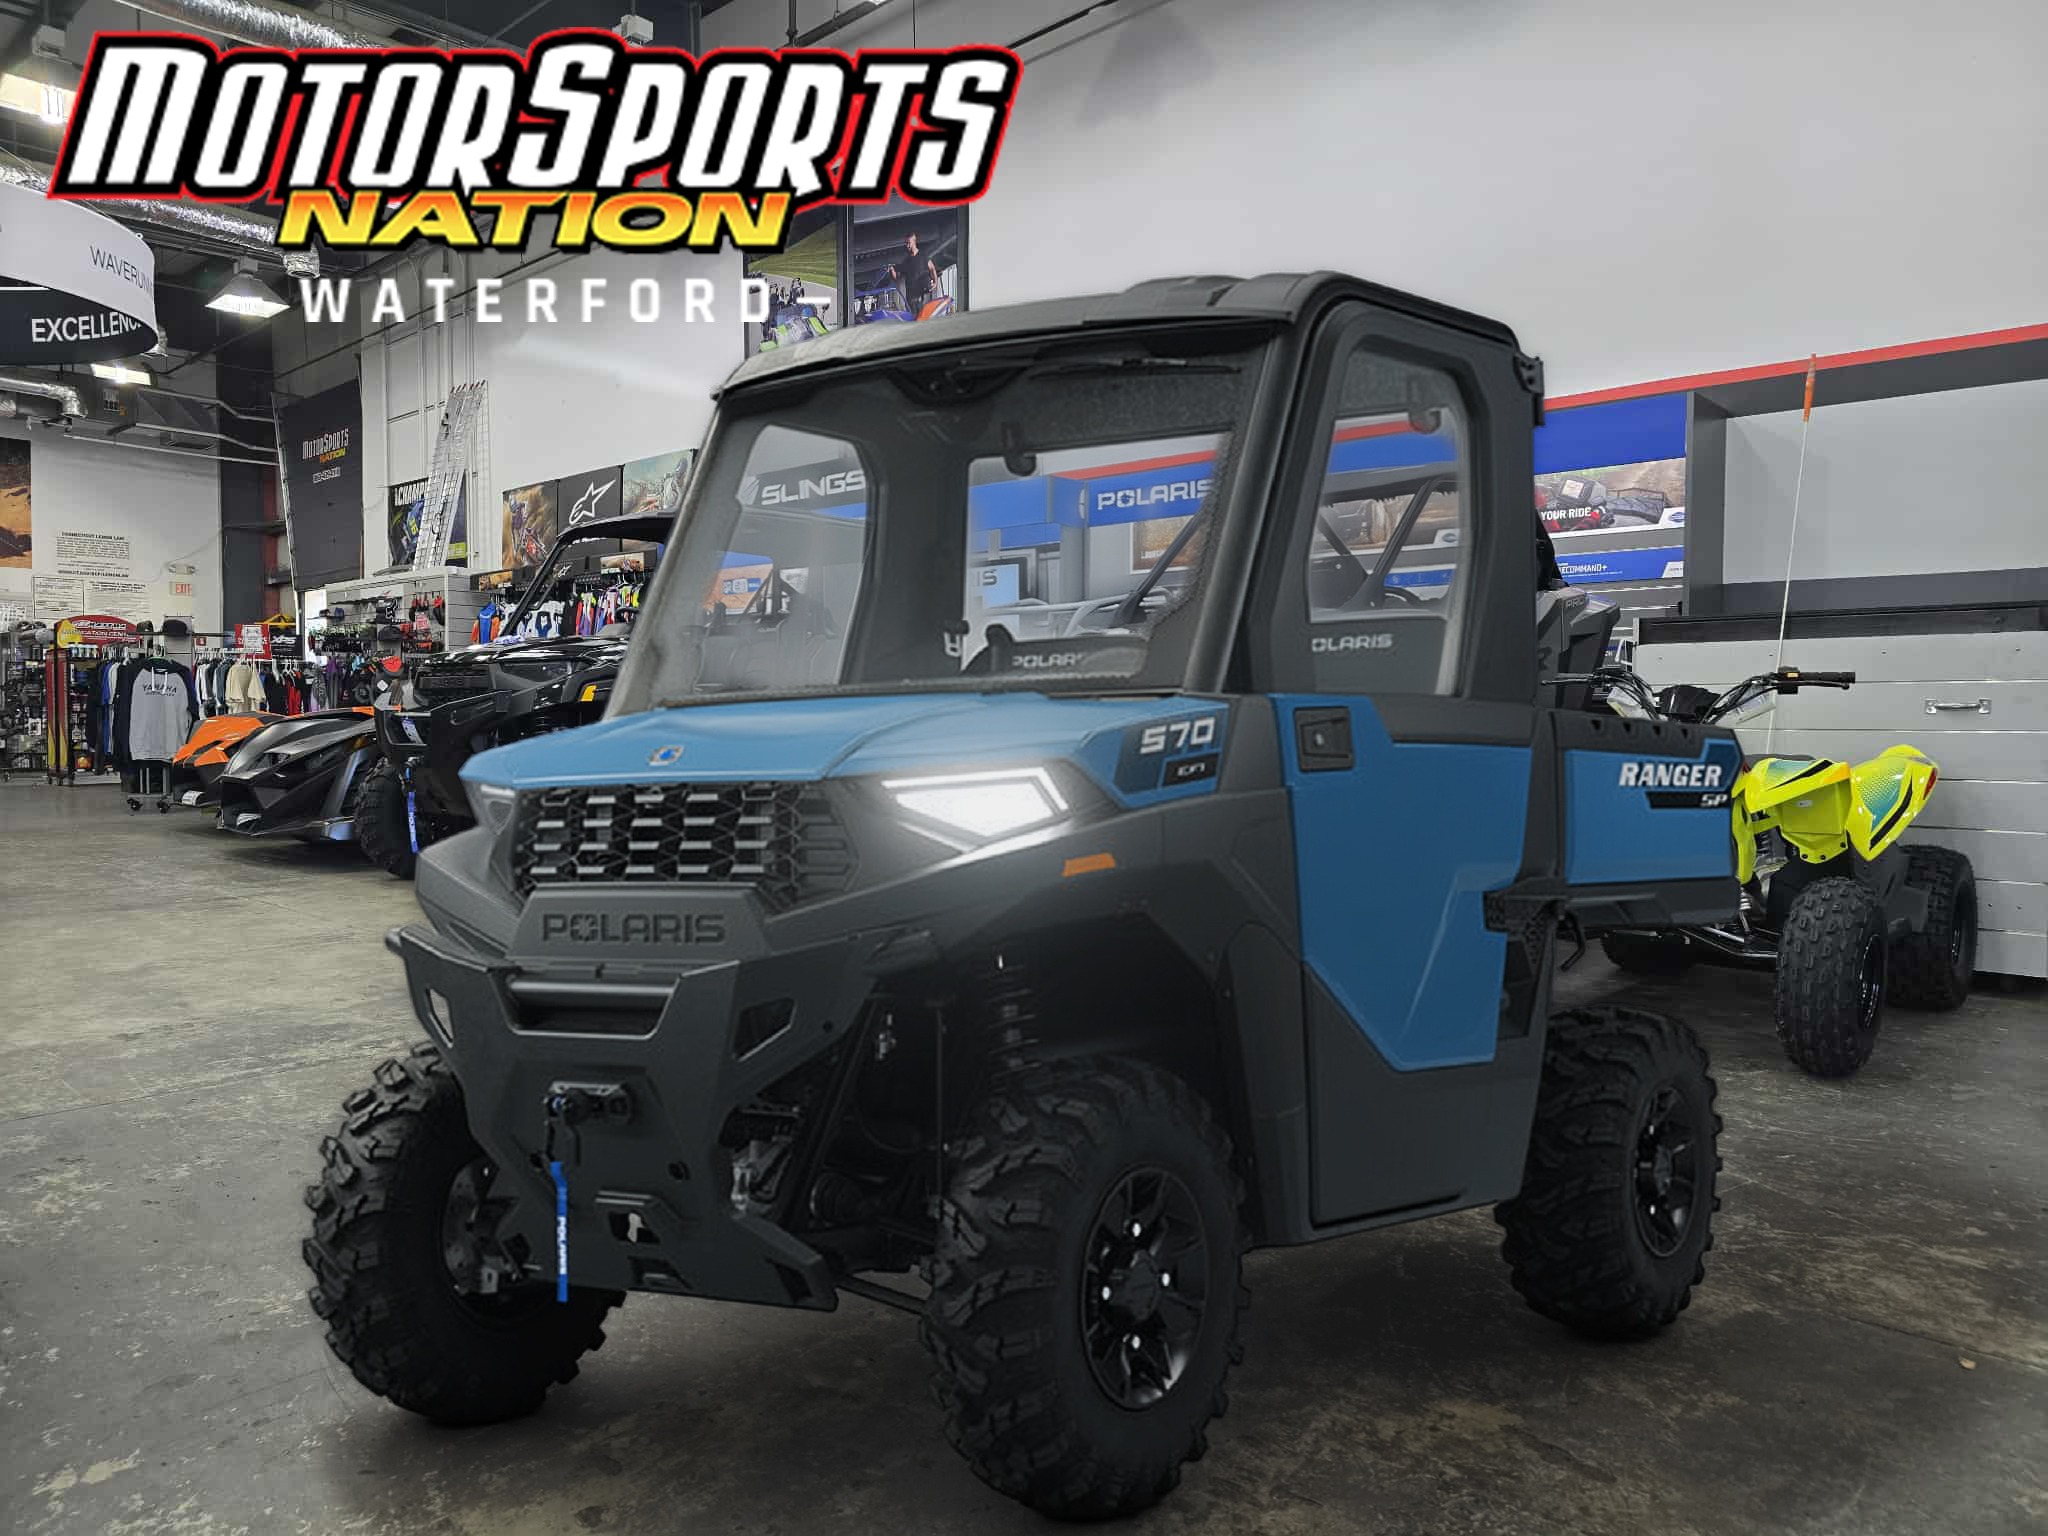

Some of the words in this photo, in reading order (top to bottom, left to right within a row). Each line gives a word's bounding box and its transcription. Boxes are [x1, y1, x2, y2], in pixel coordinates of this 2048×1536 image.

[90, 245, 153, 294] WAVERUN
[761, 469, 866, 505] SLINGS
[1097, 479, 1214, 510] POLARIS
[1540, 510, 1567, 521] YOUR
[1568, 507, 1592, 520] RIDE
[1311, 633, 1393, 653] OLARIS
[1011, 652, 1083, 668] POLAR
[1139, 716, 1216, 755] 570
[1618, 761, 1722, 787] RANGER
[541, 913, 727, 944] POLARIS
